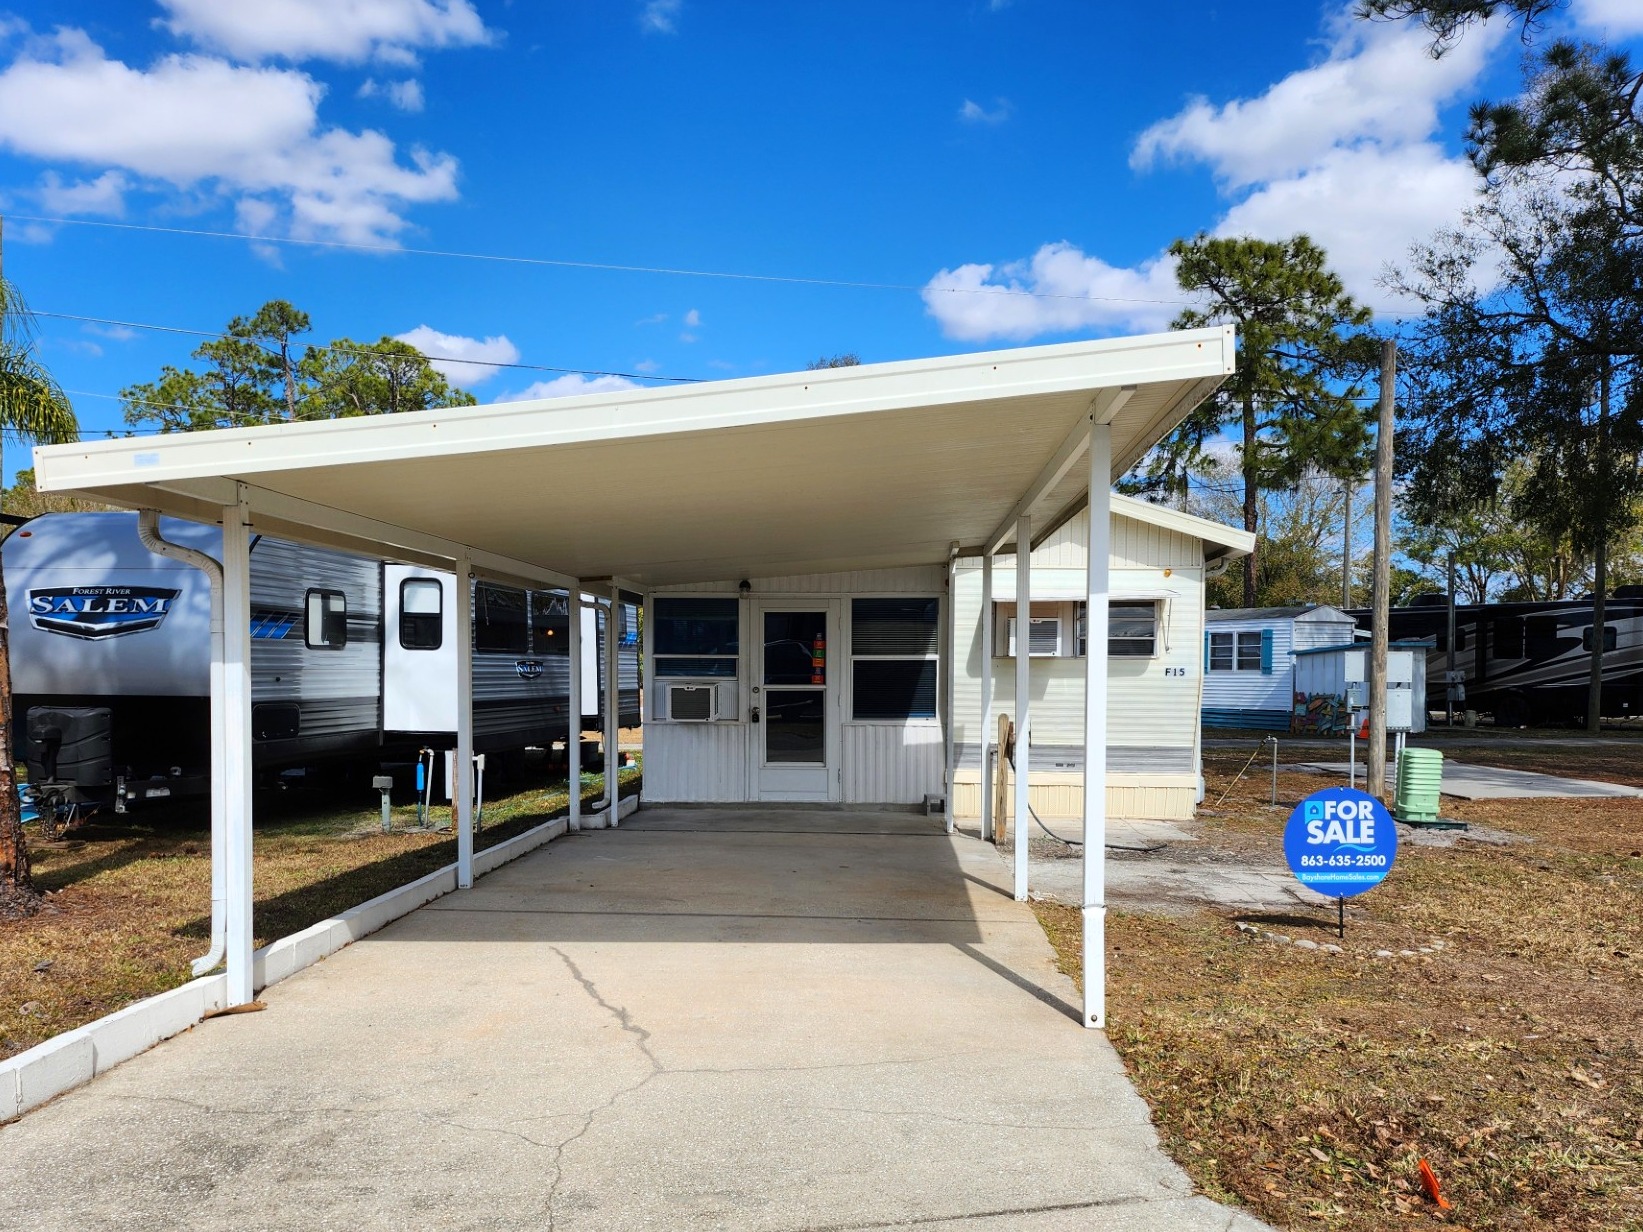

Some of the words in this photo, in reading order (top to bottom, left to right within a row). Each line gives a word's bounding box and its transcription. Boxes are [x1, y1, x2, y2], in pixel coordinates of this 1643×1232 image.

[72, 587, 103, 595] FOREST
[105, 587, 131, 595] RIVER
[30, 595, 169, 614] SALEM
[516, 664, 543, 673] SALEM
[1165, 667, 1185, 677] F15
[1324, 800, 1374, 820] FOR
[1306, 820, 1375, 845] SALE
[1301, 855, 1386, 867] 863-635-2500
[1301, 873, 1380, 882] BayshoreHomeSales.com
